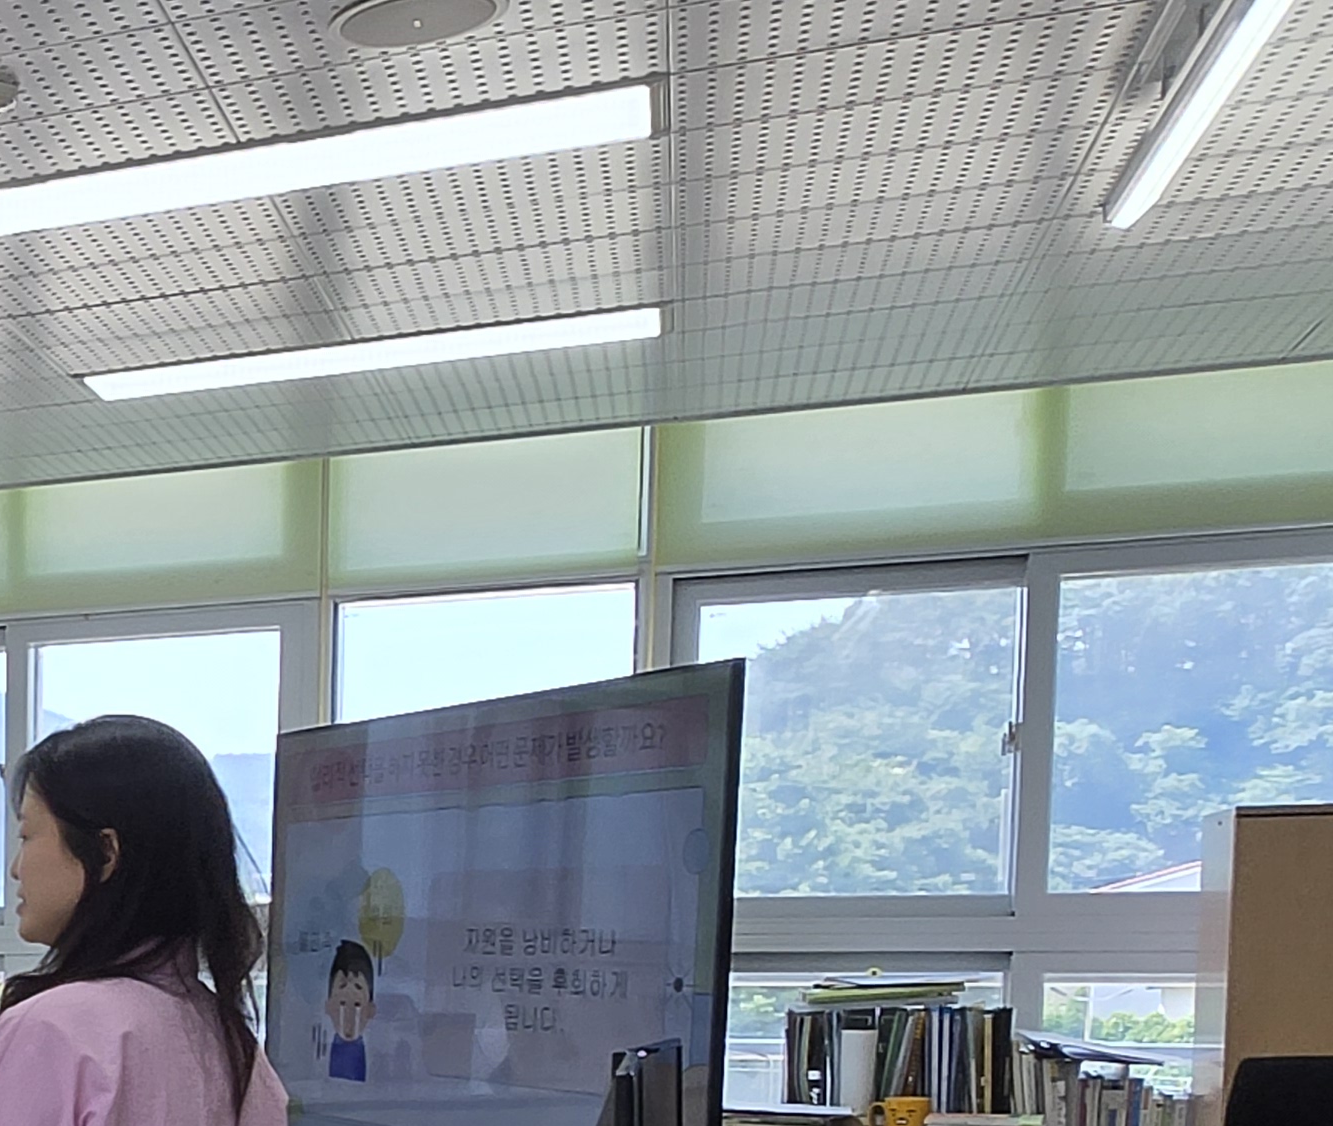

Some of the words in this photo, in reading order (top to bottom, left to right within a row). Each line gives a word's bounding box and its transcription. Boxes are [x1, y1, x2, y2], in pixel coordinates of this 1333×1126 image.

[463, 925, 515, 956] 자원을
[522, 927, 618, 957] 낭비하거나
[452, 965, 484, 992] 나의
[491, 966, 544, 996] 선택을
[551, 967, 630, 999] 후회하게
[504, 1003, 565, 1036] 됩니다.
